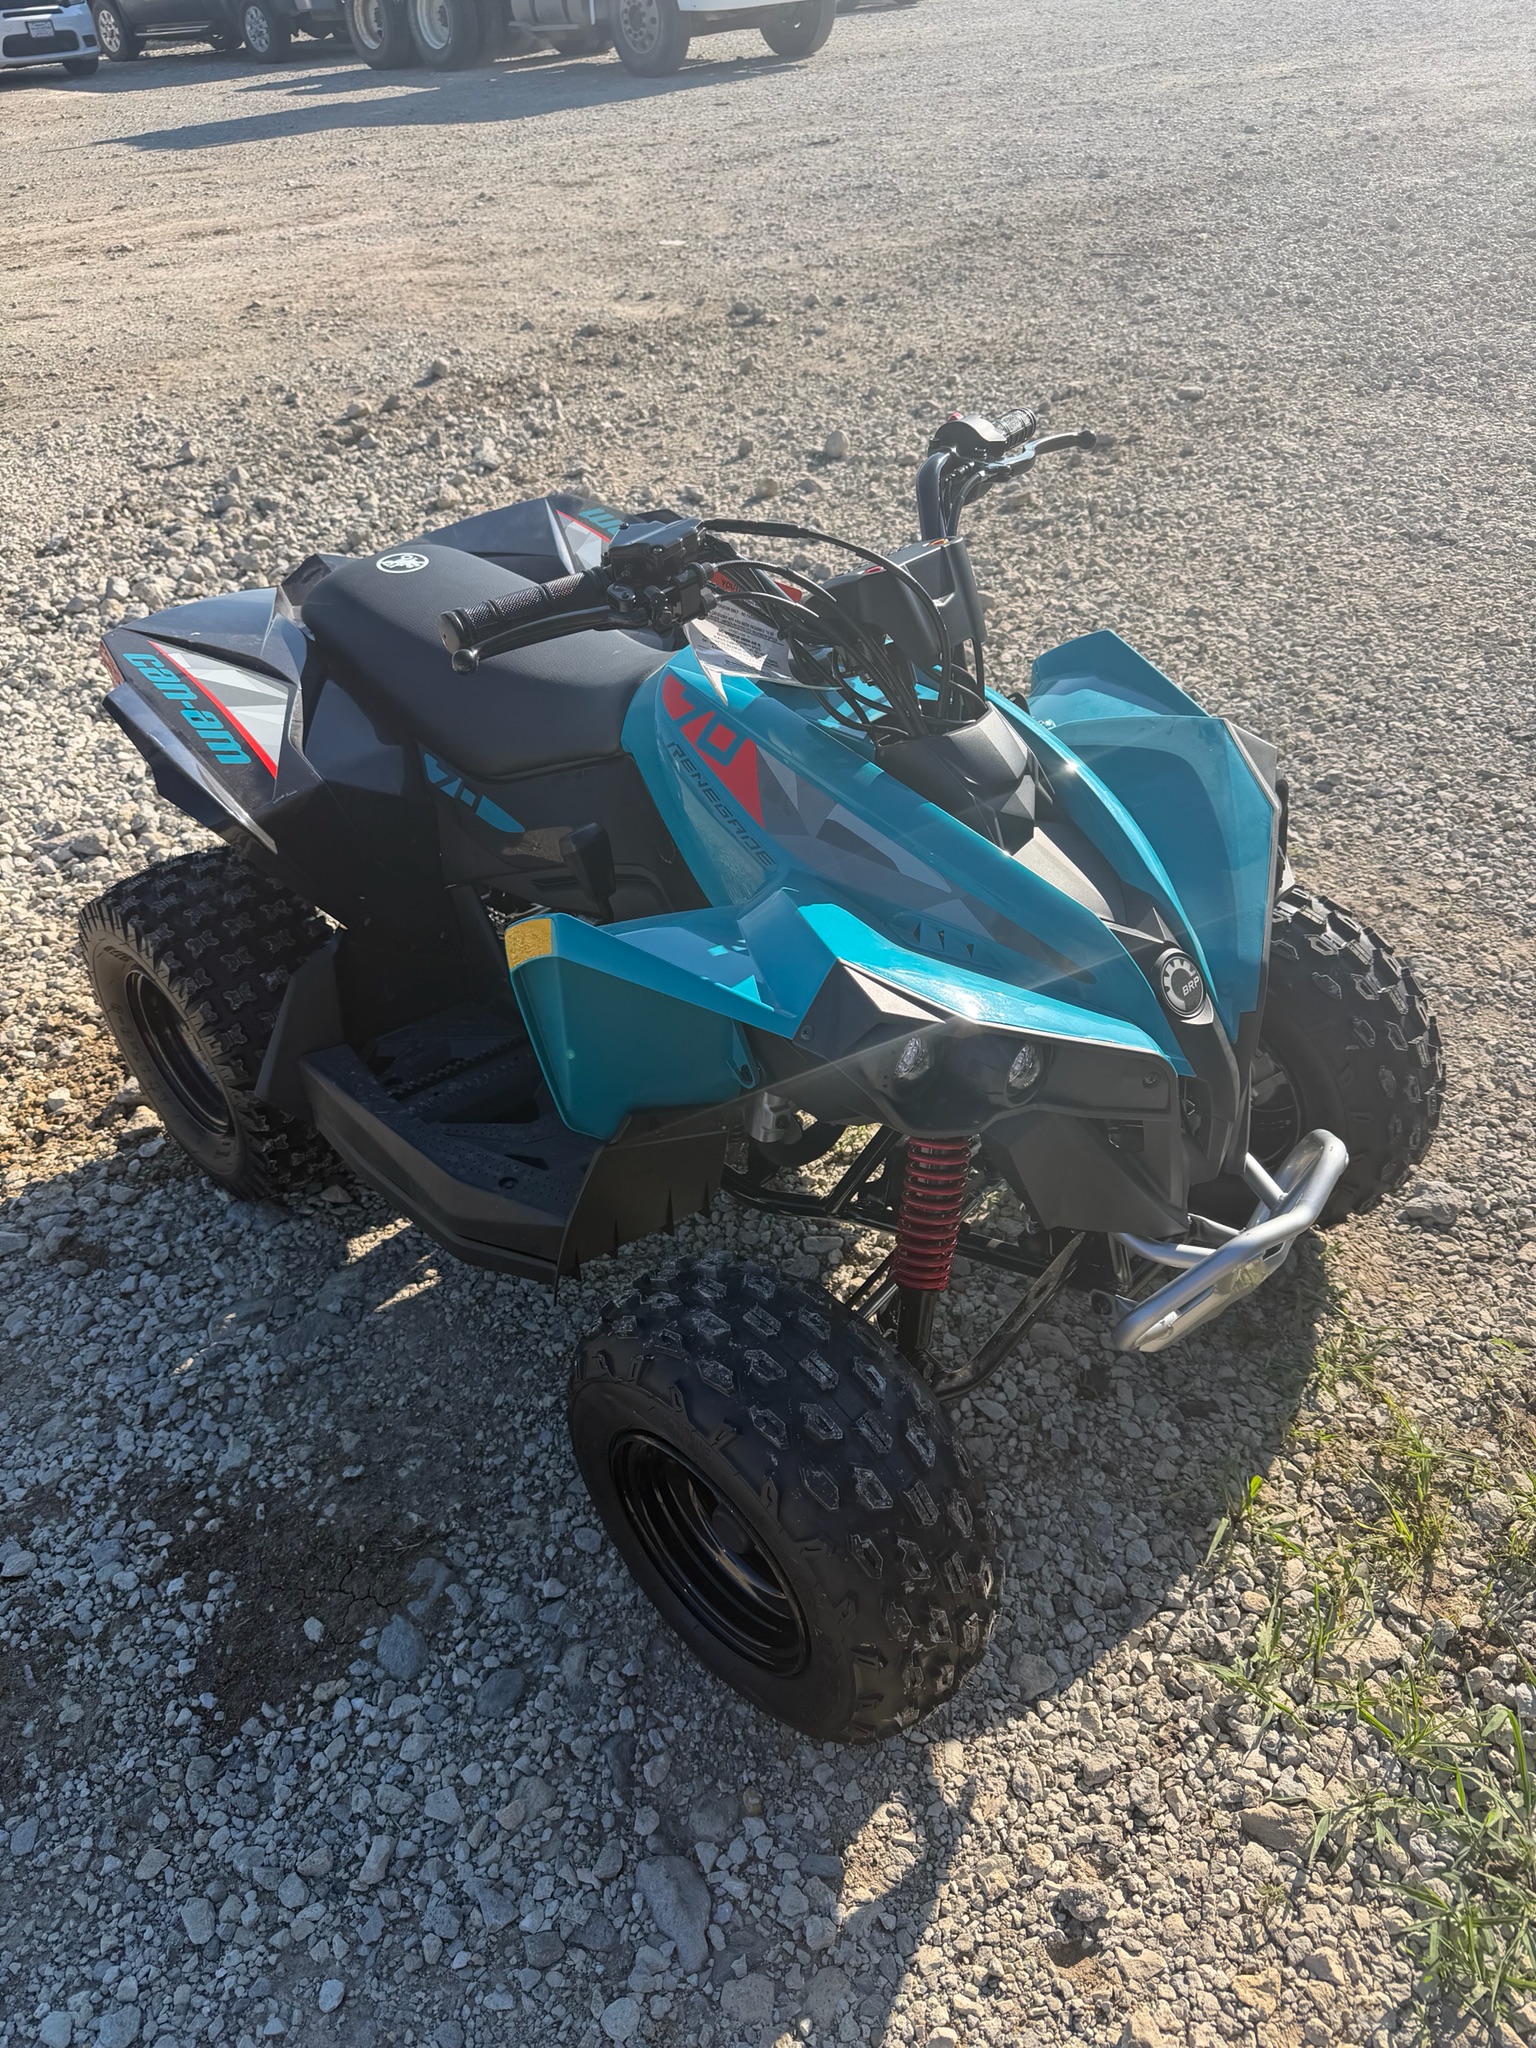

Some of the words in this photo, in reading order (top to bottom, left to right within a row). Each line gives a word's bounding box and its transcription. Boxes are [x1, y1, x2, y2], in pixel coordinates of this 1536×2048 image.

[123, 653, 252, 765] can-am
[674, 688, 747, 768] 70
[667, 741, 776, 871] RENEGADE
[1182, 975, 1200, 997] BRP
